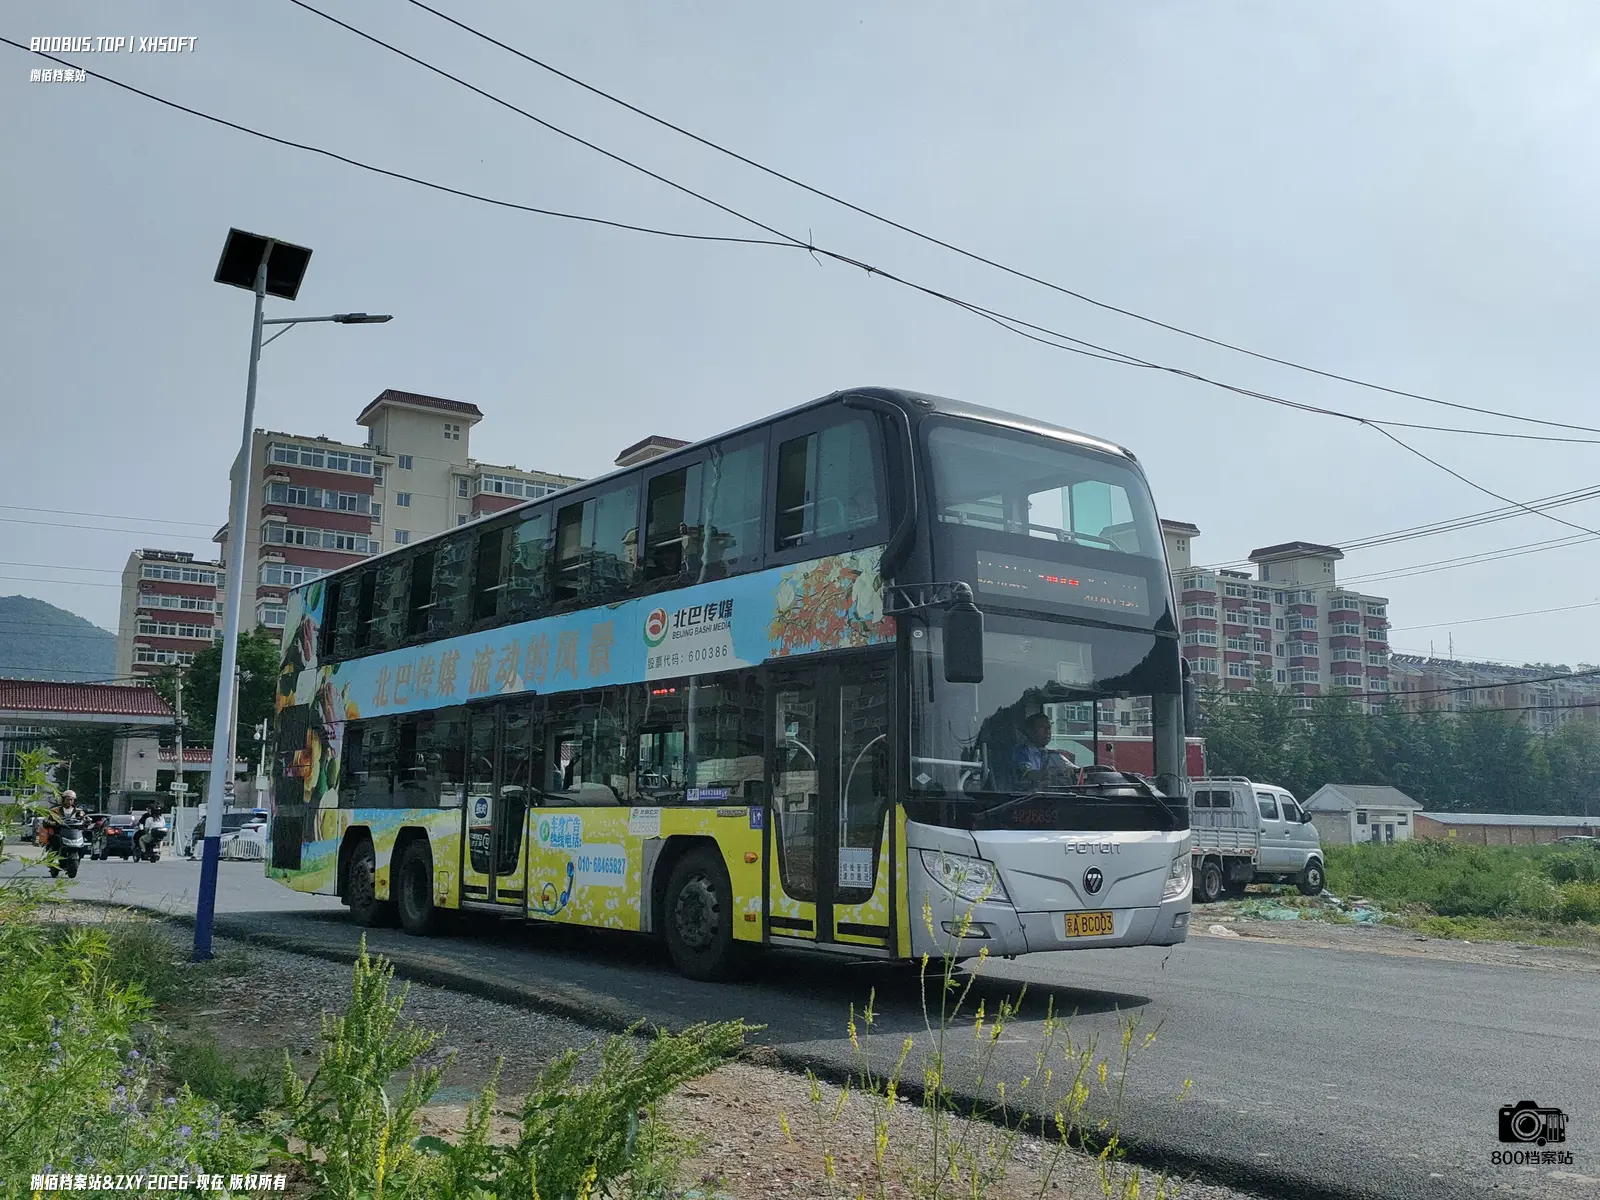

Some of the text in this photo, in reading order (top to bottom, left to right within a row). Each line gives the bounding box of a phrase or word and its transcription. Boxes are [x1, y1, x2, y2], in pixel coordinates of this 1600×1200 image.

[673, 598, 734, 628] 北巴传媒
[672, 620, 732, 640] BEIJING BASHI MEDIA
[372, 619, 615, 707] 北巴传媒 流动的风景
[688, 644, 728, 662] 600386
[1064, 842, 1121, 855] FOTON
